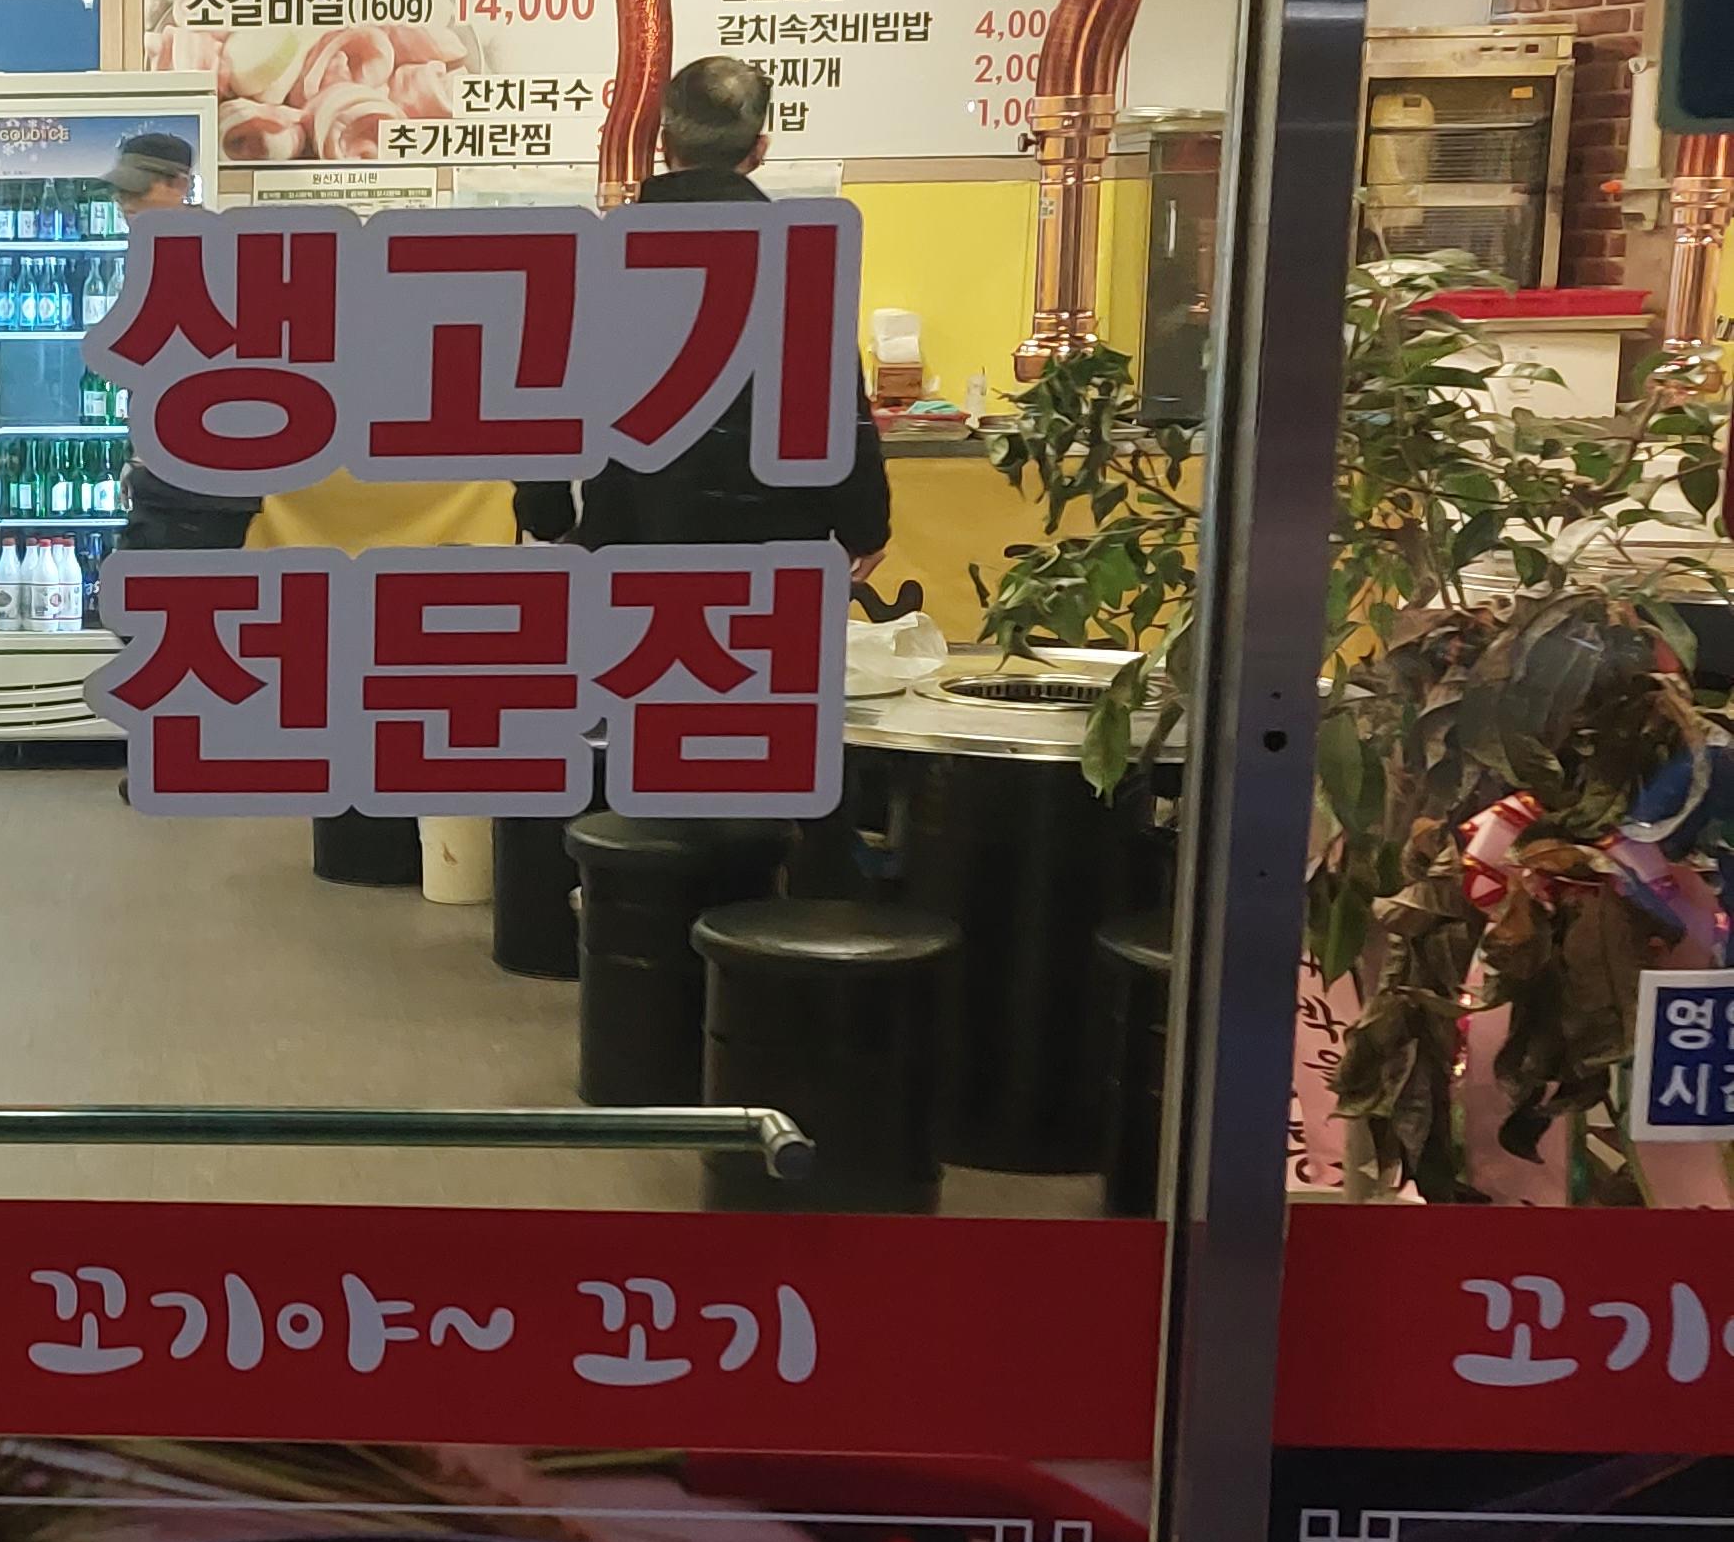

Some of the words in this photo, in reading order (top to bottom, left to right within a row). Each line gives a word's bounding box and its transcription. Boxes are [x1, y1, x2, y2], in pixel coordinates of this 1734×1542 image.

[717, 12, 933, 47] 갈치속젓비빔밥
[975, 9, 1046, 42] 4,00
[461, 77, 594, 113] 잔치국수
[748, 57, 841, 89] 장찌개
[974, 53, 1038, 85] 2,00
[387, 119, 553, 159] 추가계란찜
[108, 225, 837, 471] 생고기
[108, 568, 824, 793] 전문점
[1666, 998, 1734, 1052] 영
[28, 1266, 515, 1375] 꼬기야~
[572, 1278, 817, 1386] 꼬기
[1453, 1275, 1734, 1387] 꼬기
